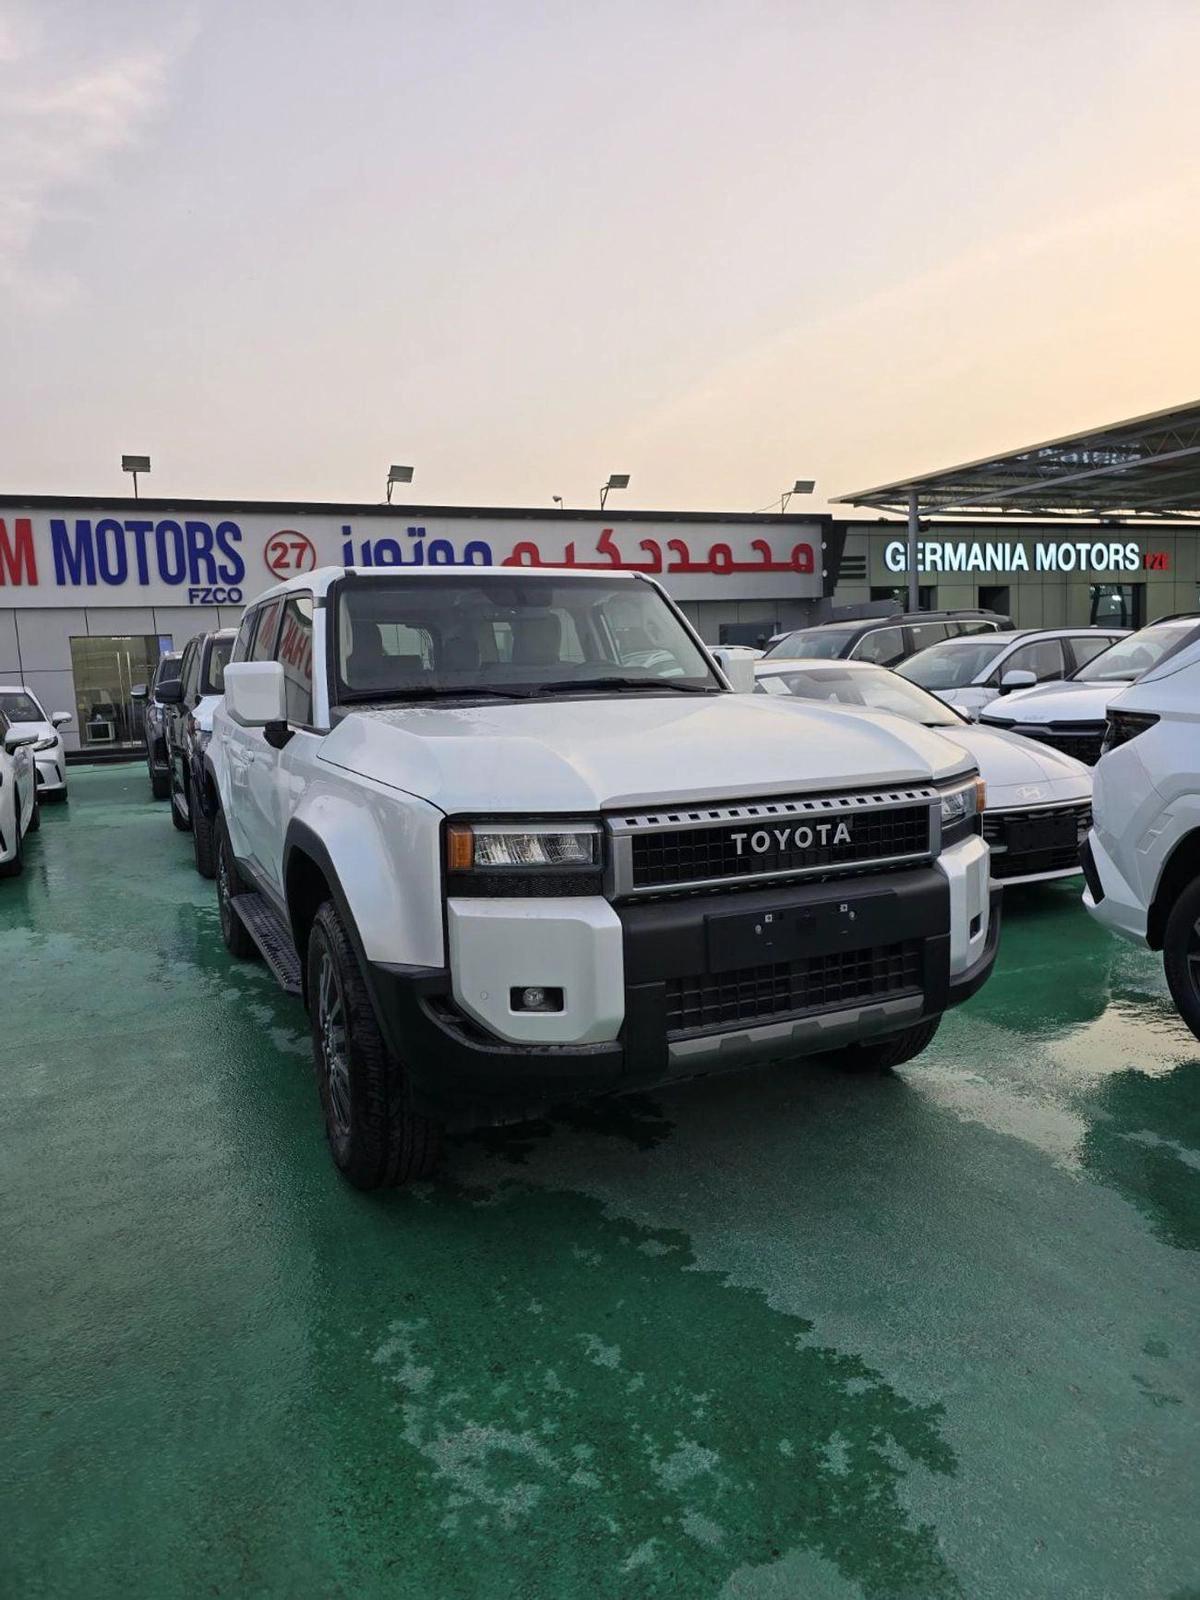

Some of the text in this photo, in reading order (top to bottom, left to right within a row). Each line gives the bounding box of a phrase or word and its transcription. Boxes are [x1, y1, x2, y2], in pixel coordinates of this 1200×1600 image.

[50, 518, 245, 586] MOTORS
[270, 542, 308, 569] 27
[1035, 543, 1140, 571] MOTORS
[188, 587, 243, 604] FZCO
[731, 823, 851, 855] TOYOTA
